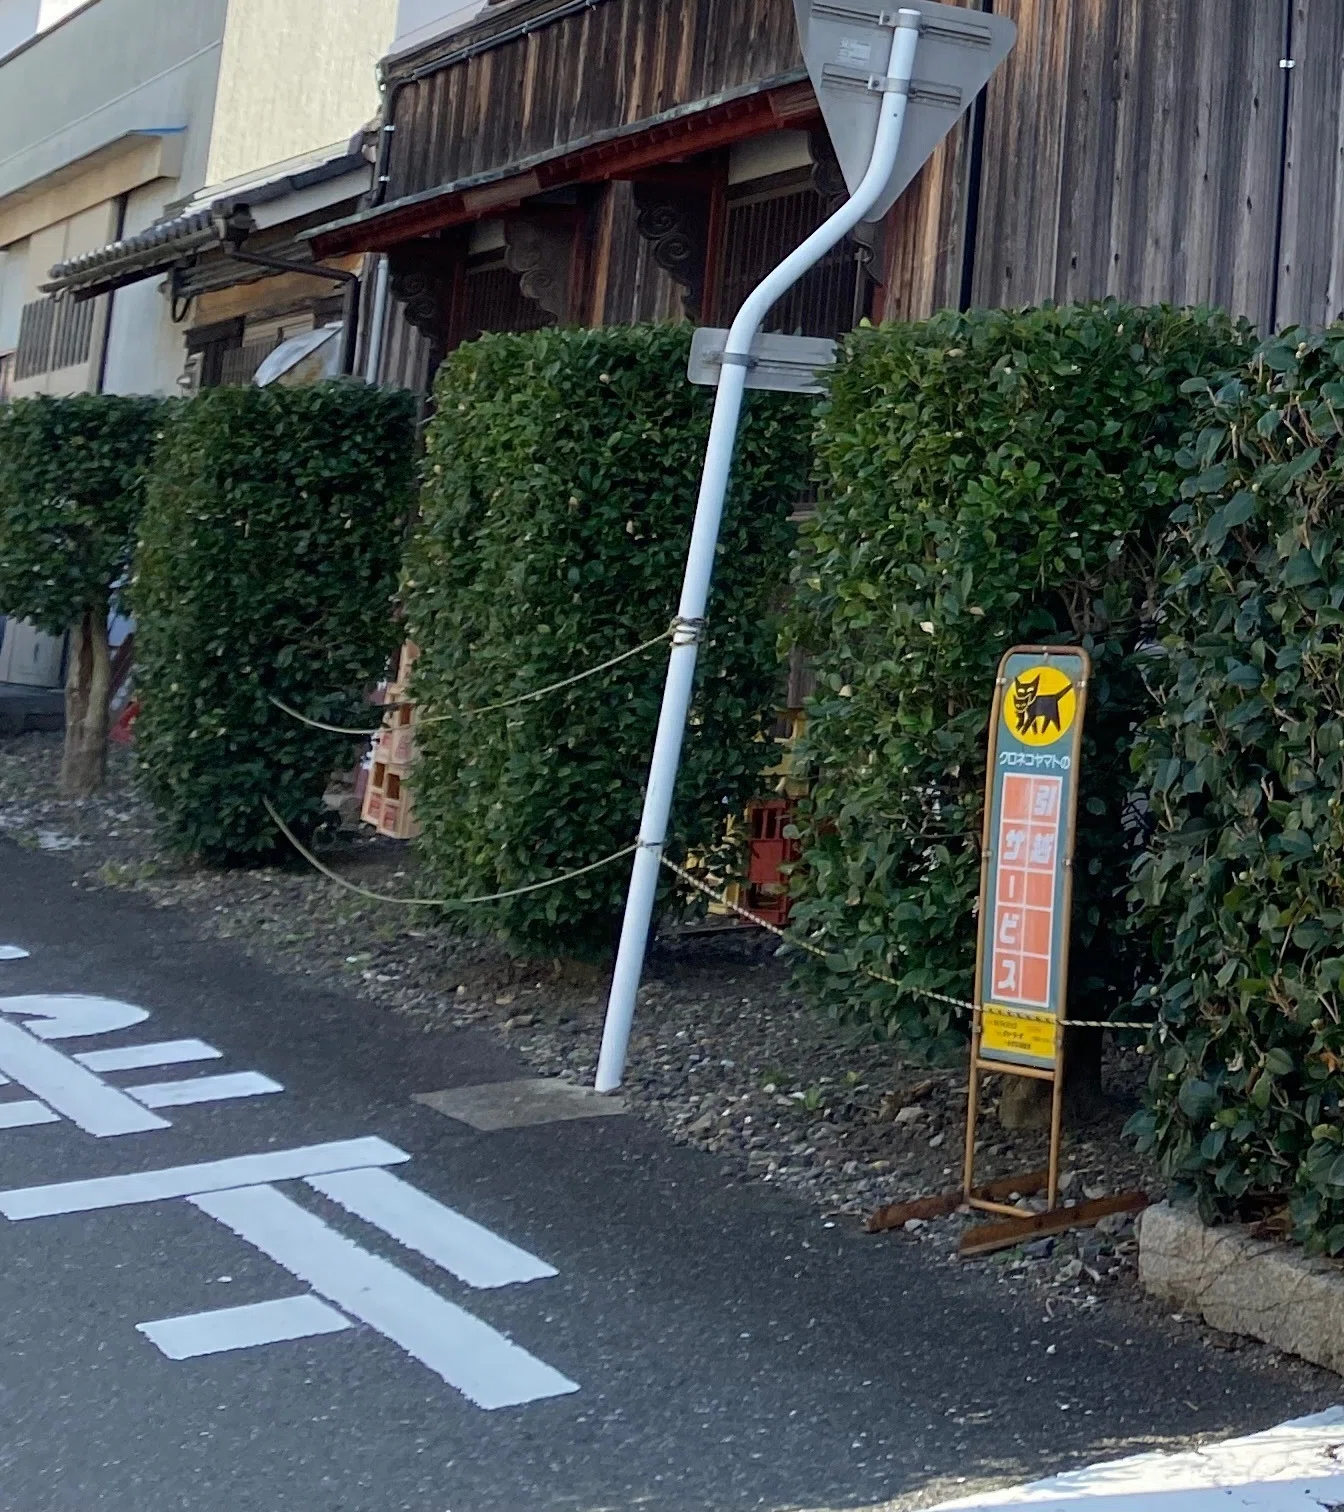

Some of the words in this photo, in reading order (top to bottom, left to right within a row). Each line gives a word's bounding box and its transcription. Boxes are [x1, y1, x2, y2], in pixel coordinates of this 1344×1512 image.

[999, 751, 1070, 770] クロネコヤマトの
